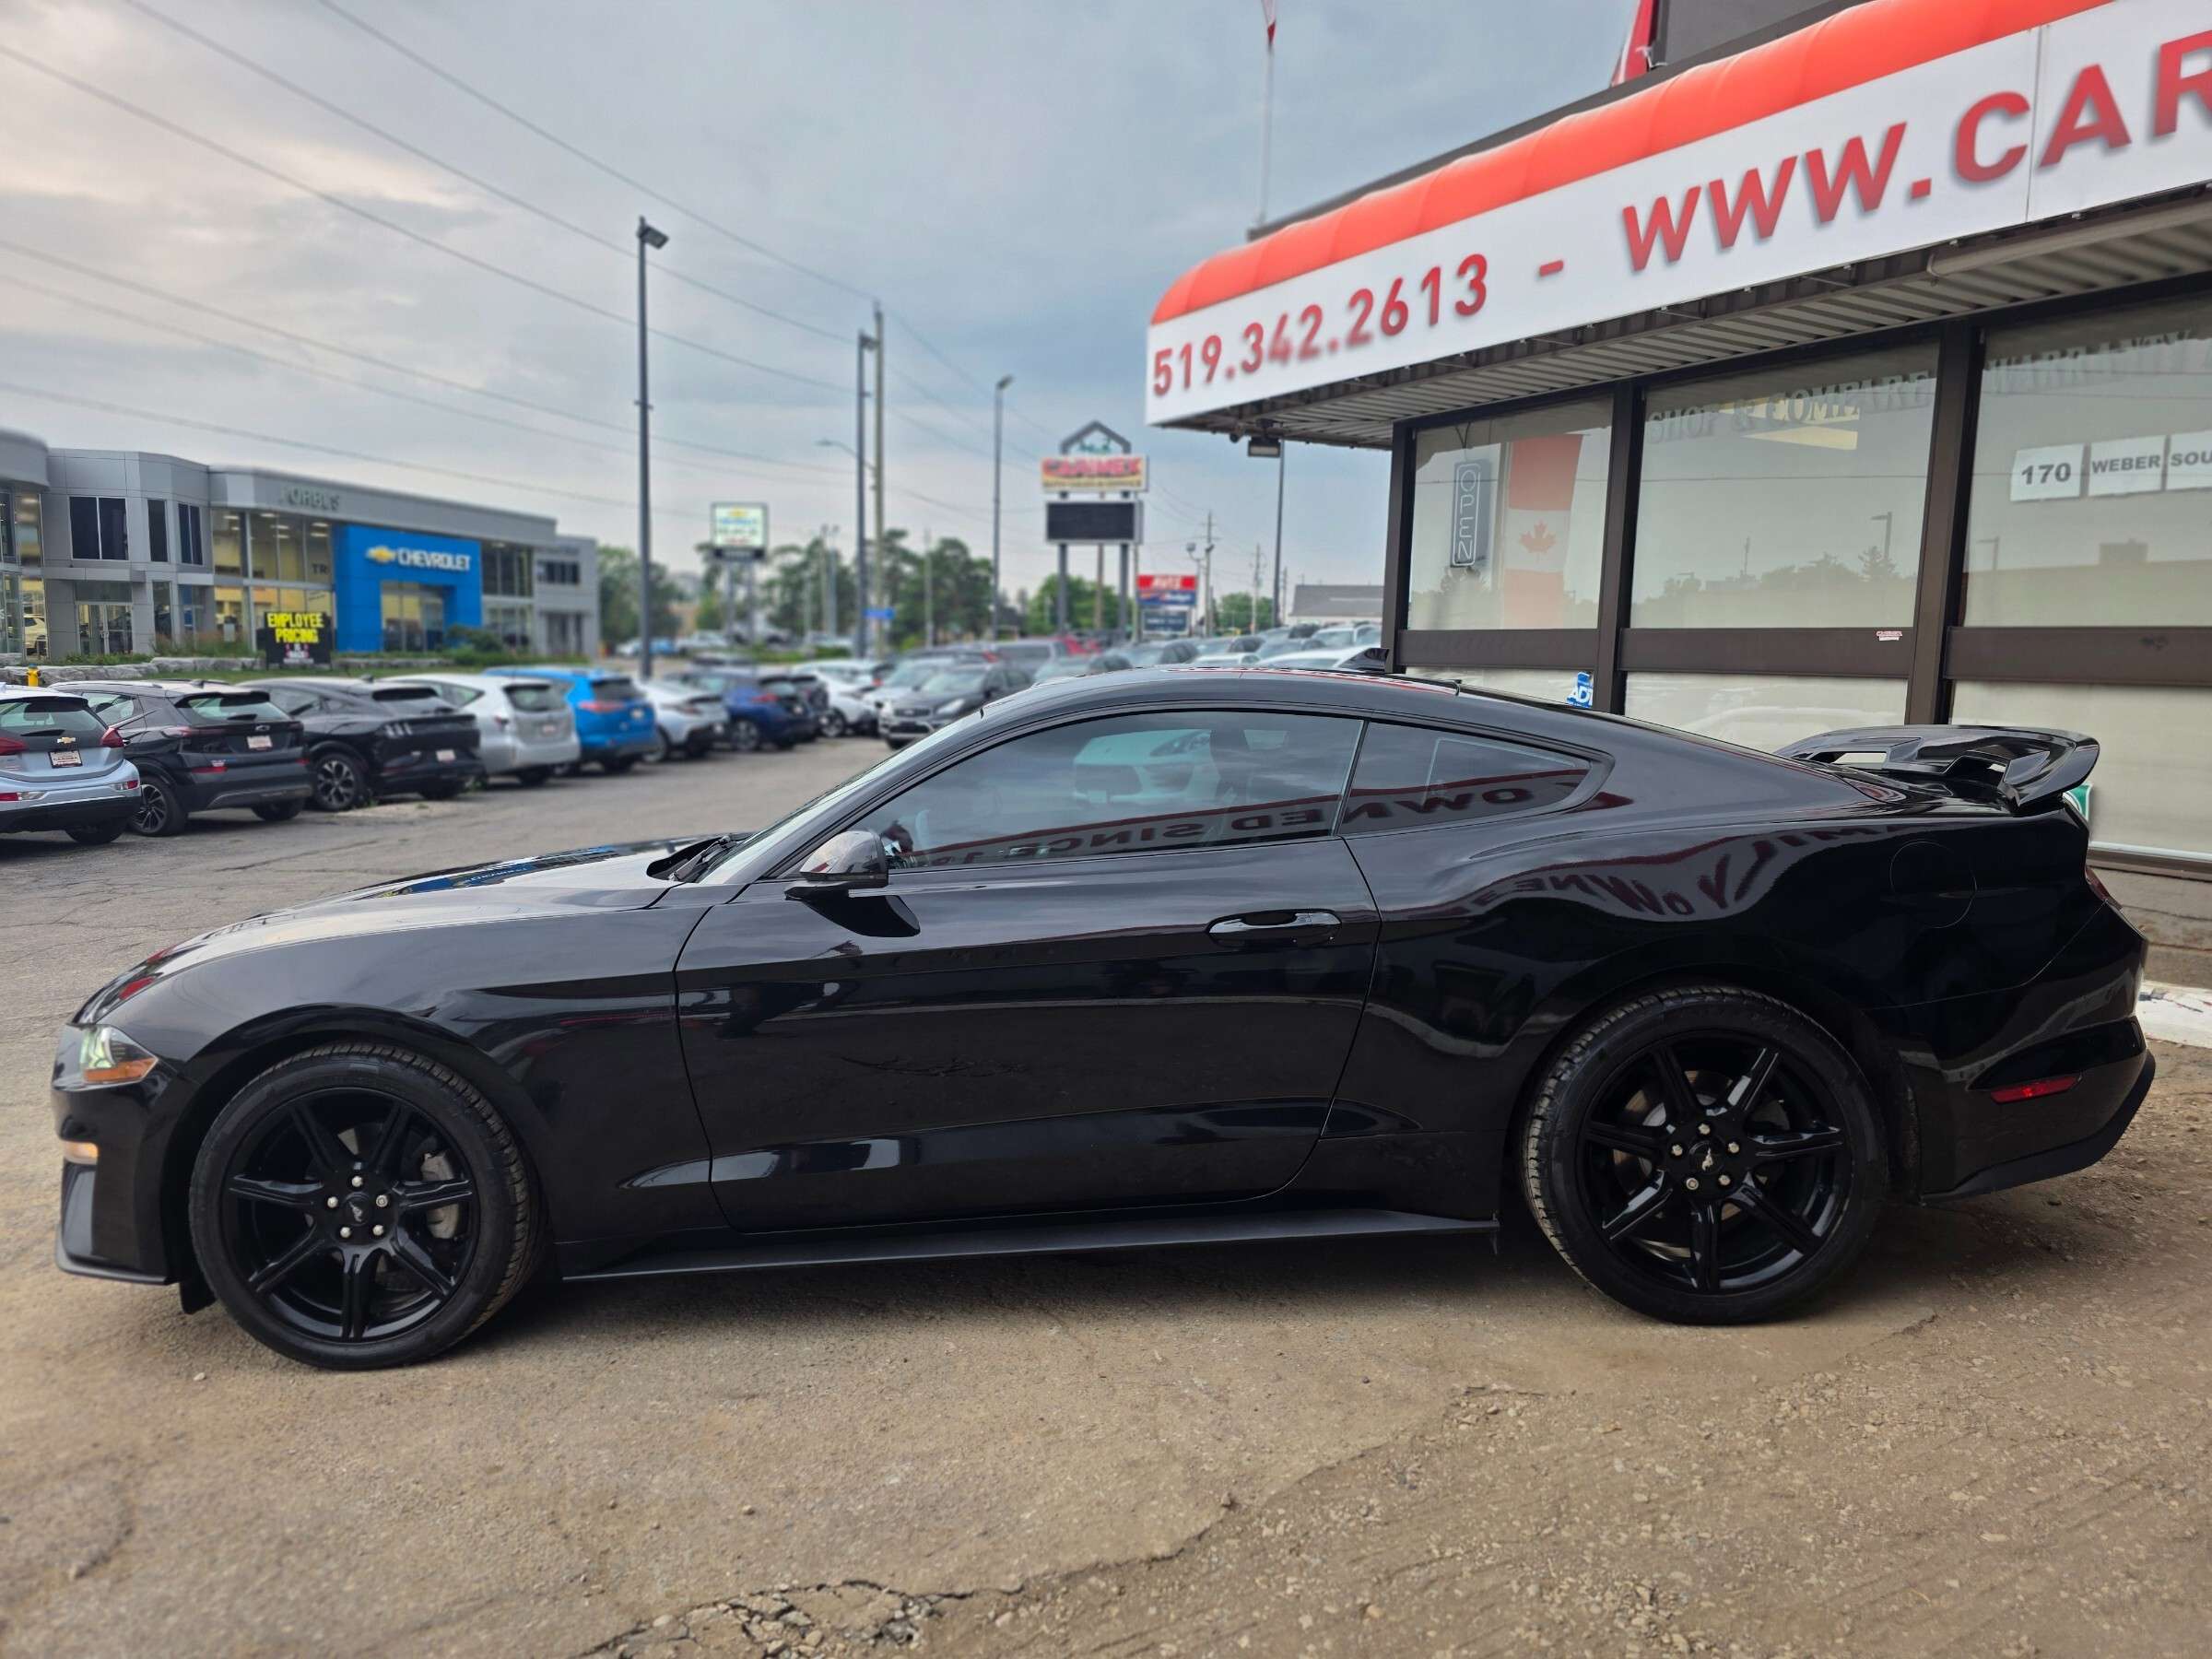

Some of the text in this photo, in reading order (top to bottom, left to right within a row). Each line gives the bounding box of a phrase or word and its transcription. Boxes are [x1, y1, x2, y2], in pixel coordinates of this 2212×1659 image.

[1153, 253, 1488, 395] 519.342.2613
[1622, 29, 2212, 272] WWW.CAR
[2021, 451, 2212, 485] 170 WEBER SOU
[1457, 470, 1477, 560] OPEN
[397, 548, 472, 571] CHEVROLET
[267, 613, 324, 628] EMPLOYEE
[276, 629, 319, 643] PRICING
